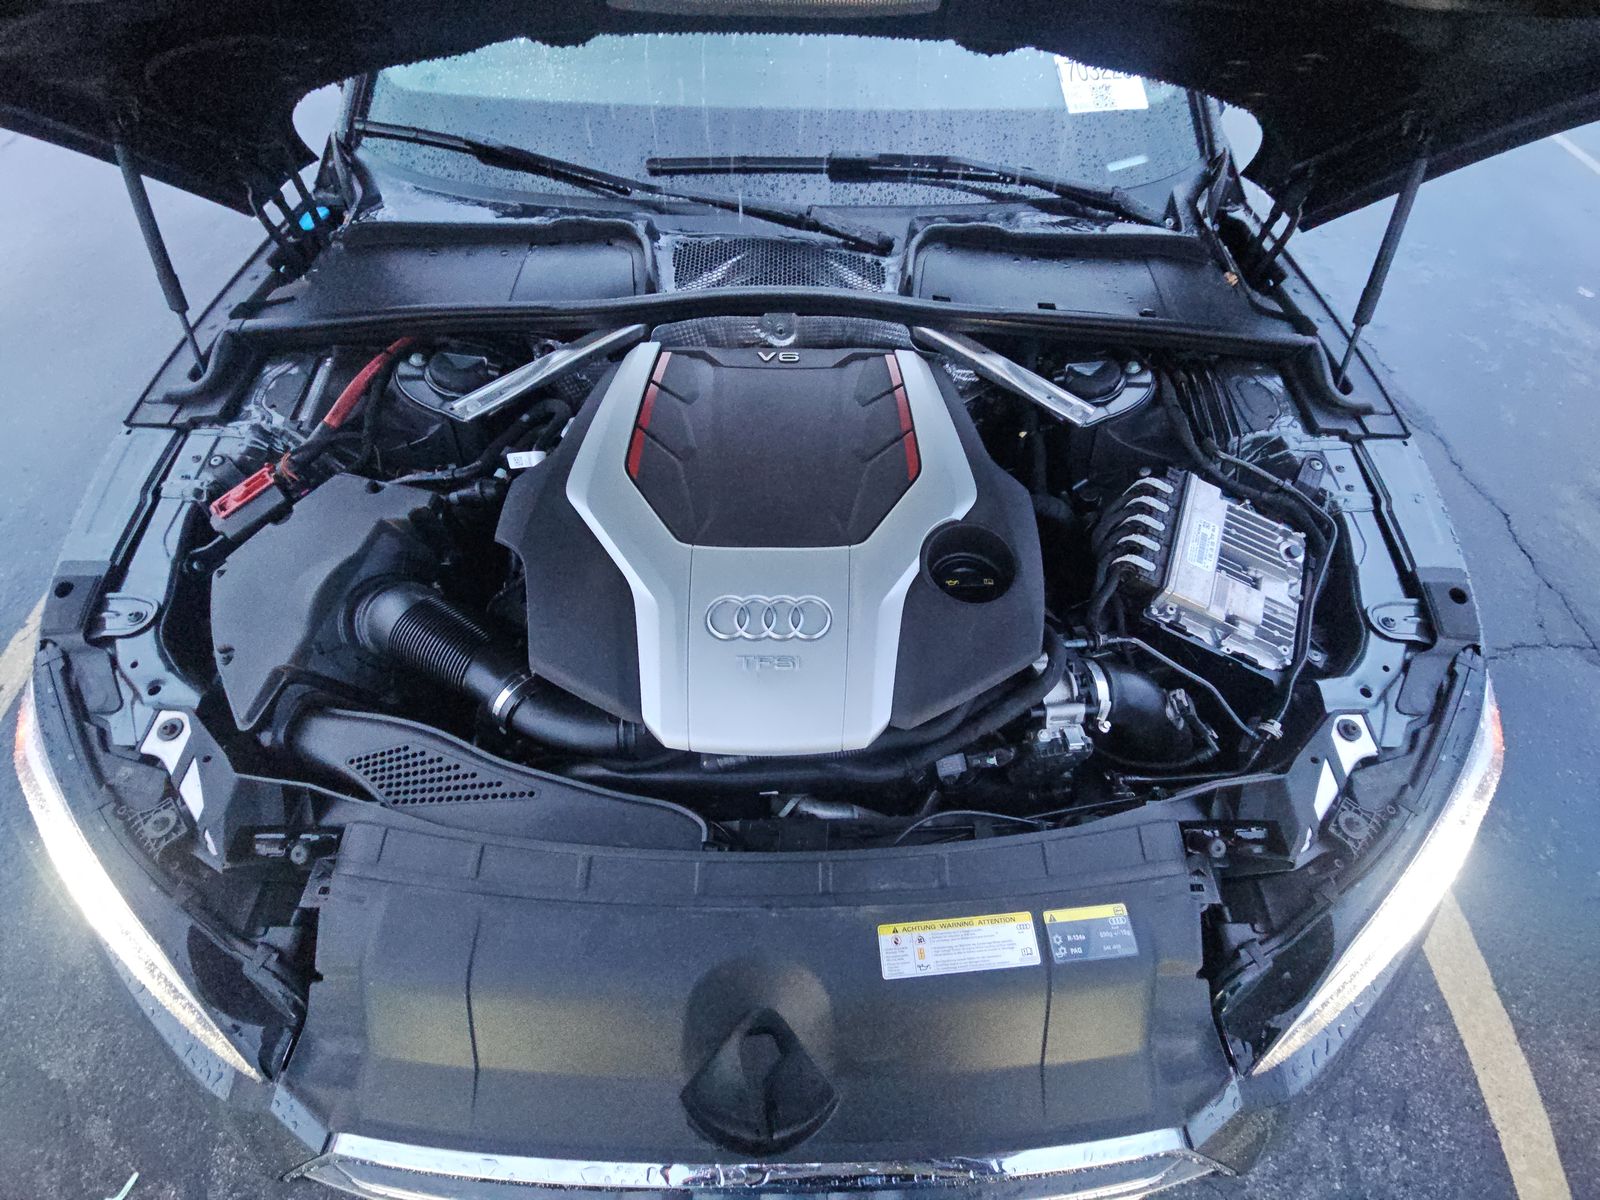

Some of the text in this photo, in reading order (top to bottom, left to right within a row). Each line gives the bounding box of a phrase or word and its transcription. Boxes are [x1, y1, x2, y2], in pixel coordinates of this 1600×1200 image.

[1064, 61, 1132, 81] 7032
[757, 351, 800, 362] V6
[735, 655, 801, 671] TFSI
[901, 916, 1016, 933] ACHTUNG WARNING ATTENTION
